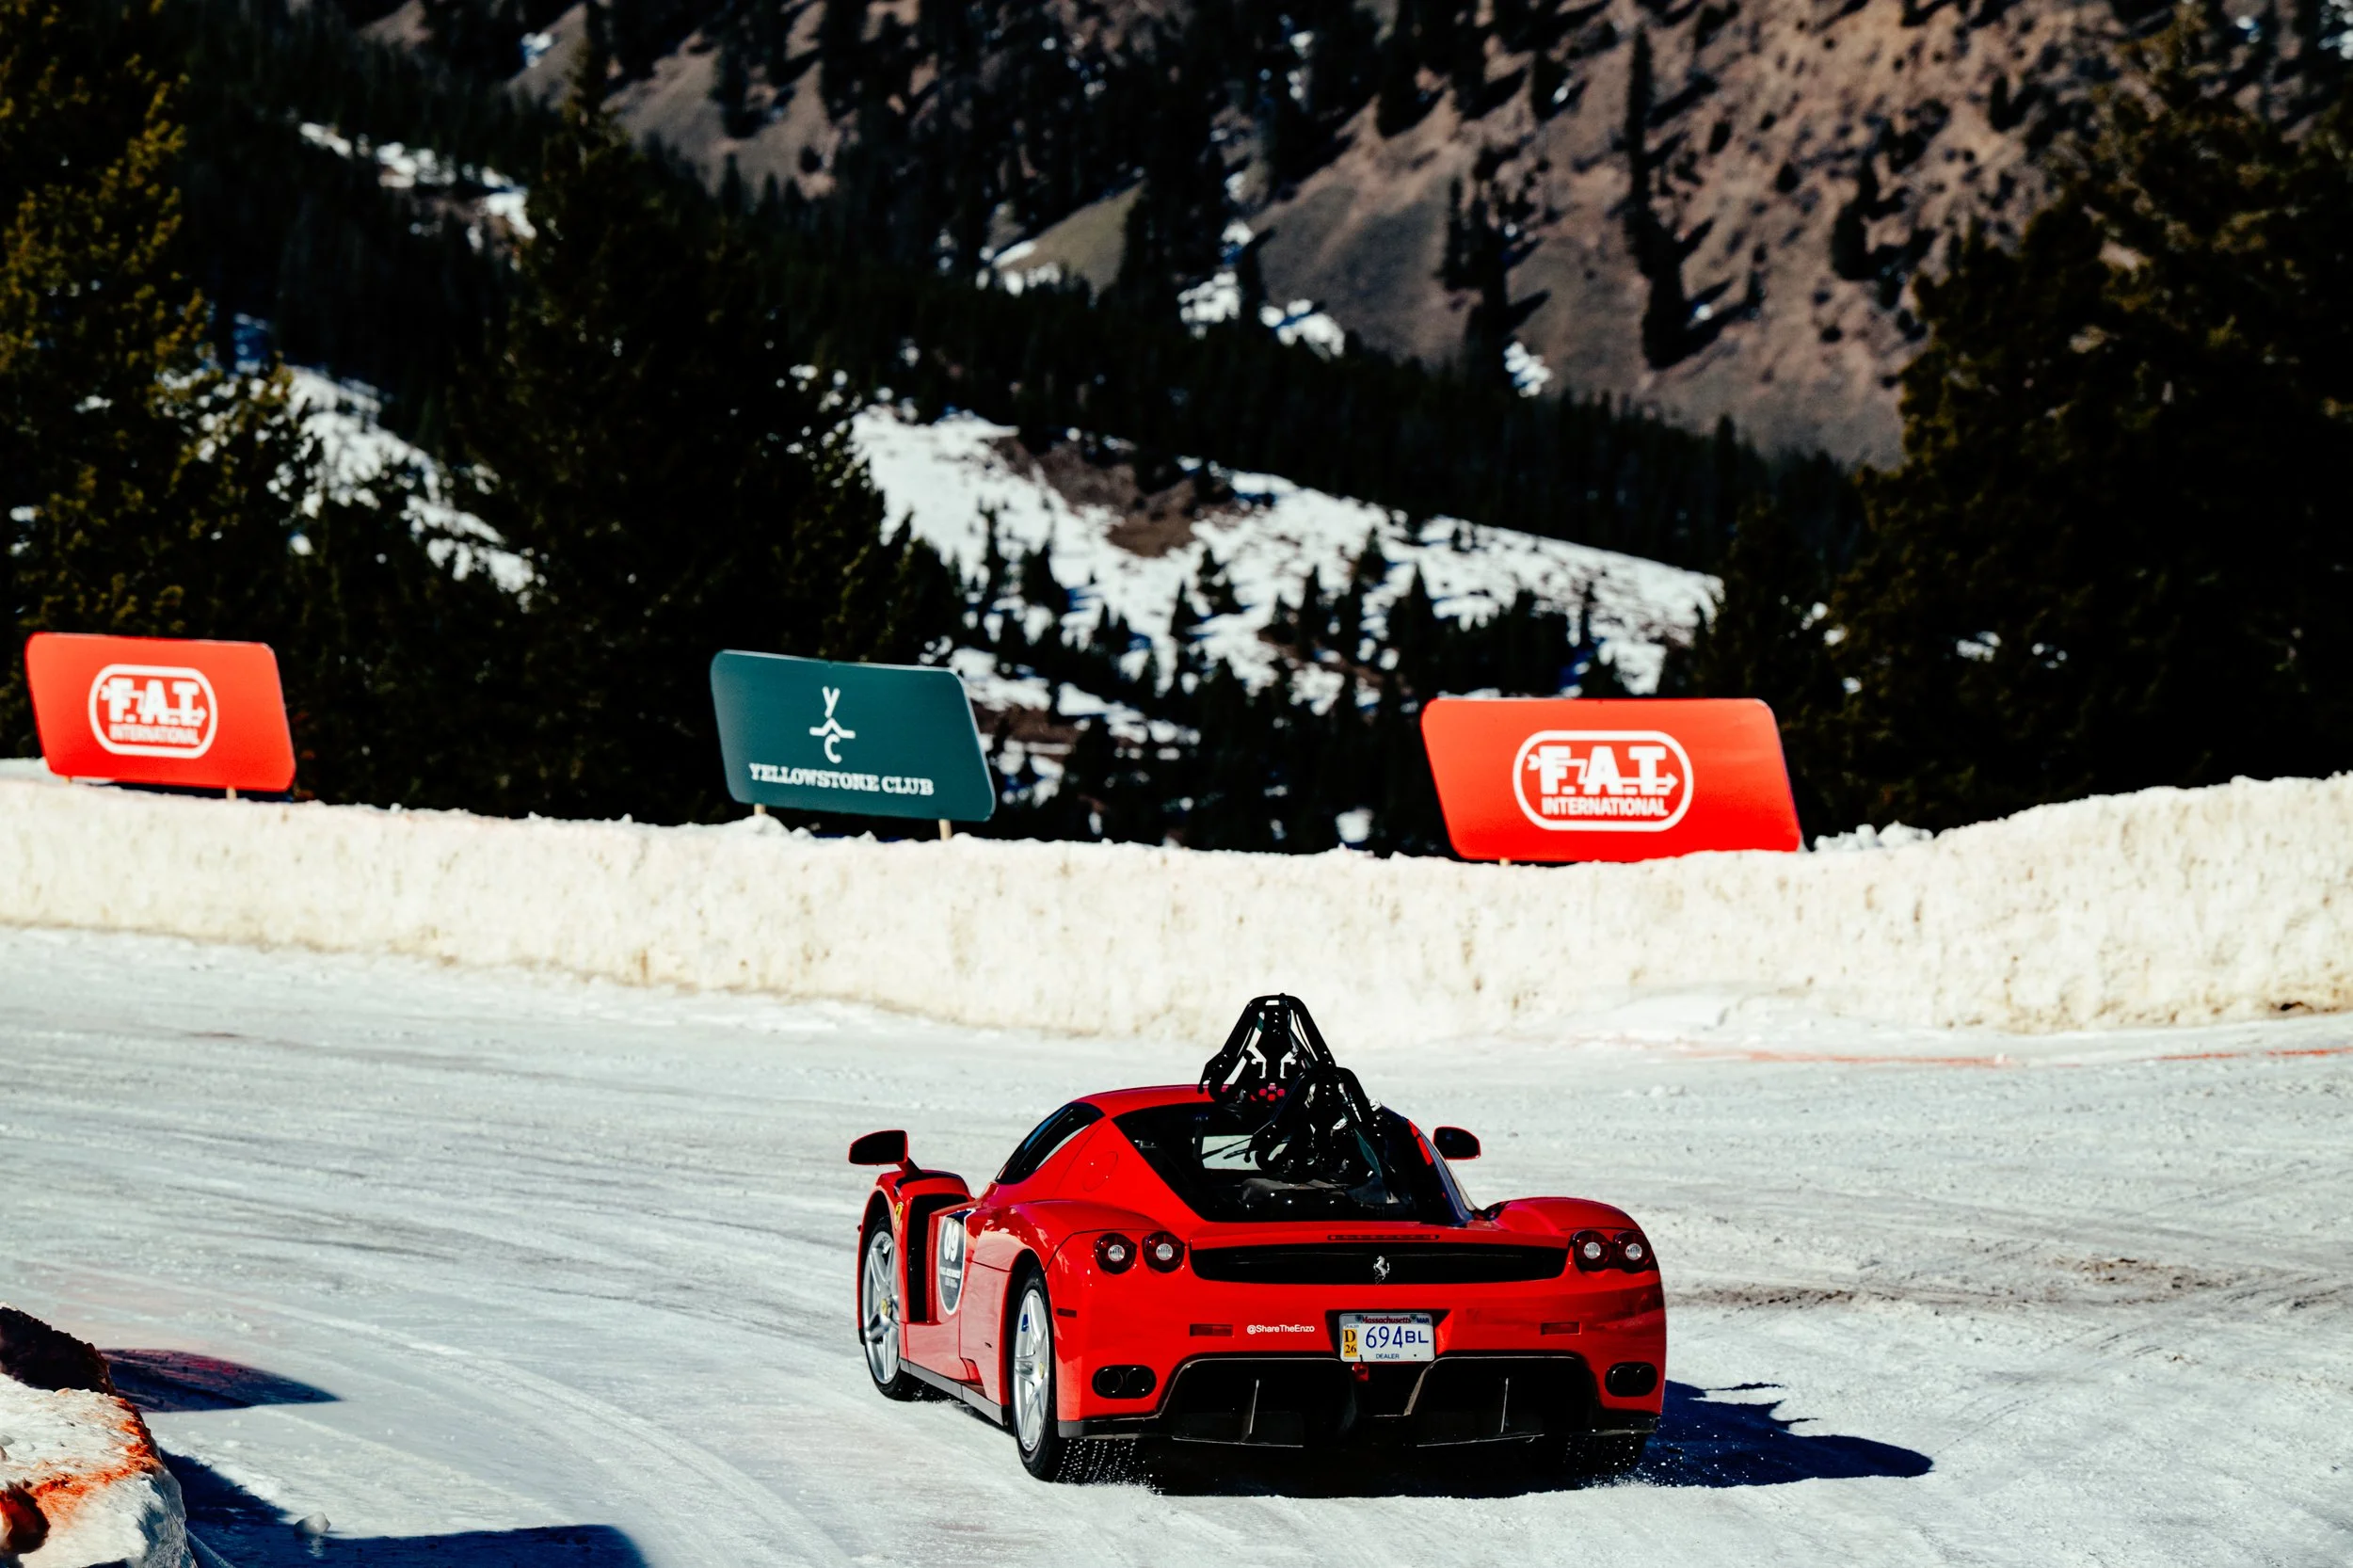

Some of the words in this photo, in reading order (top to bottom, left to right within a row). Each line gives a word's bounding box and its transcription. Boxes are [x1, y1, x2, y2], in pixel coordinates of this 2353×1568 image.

[748, 763, 880, 792] YELLOWSTONE
[881, 776, 935, 796] CLUB
[1541, 796, 1670, 817] INTERNATIONAL
[1362, 1316, 1412, 1324] Massachusetts
[1246, 1323, 1315, 1336] @ShareTheEnzo
[1344, 1329, 1356, 1343] D
[1345, 1344, 1357, 1353] 26
